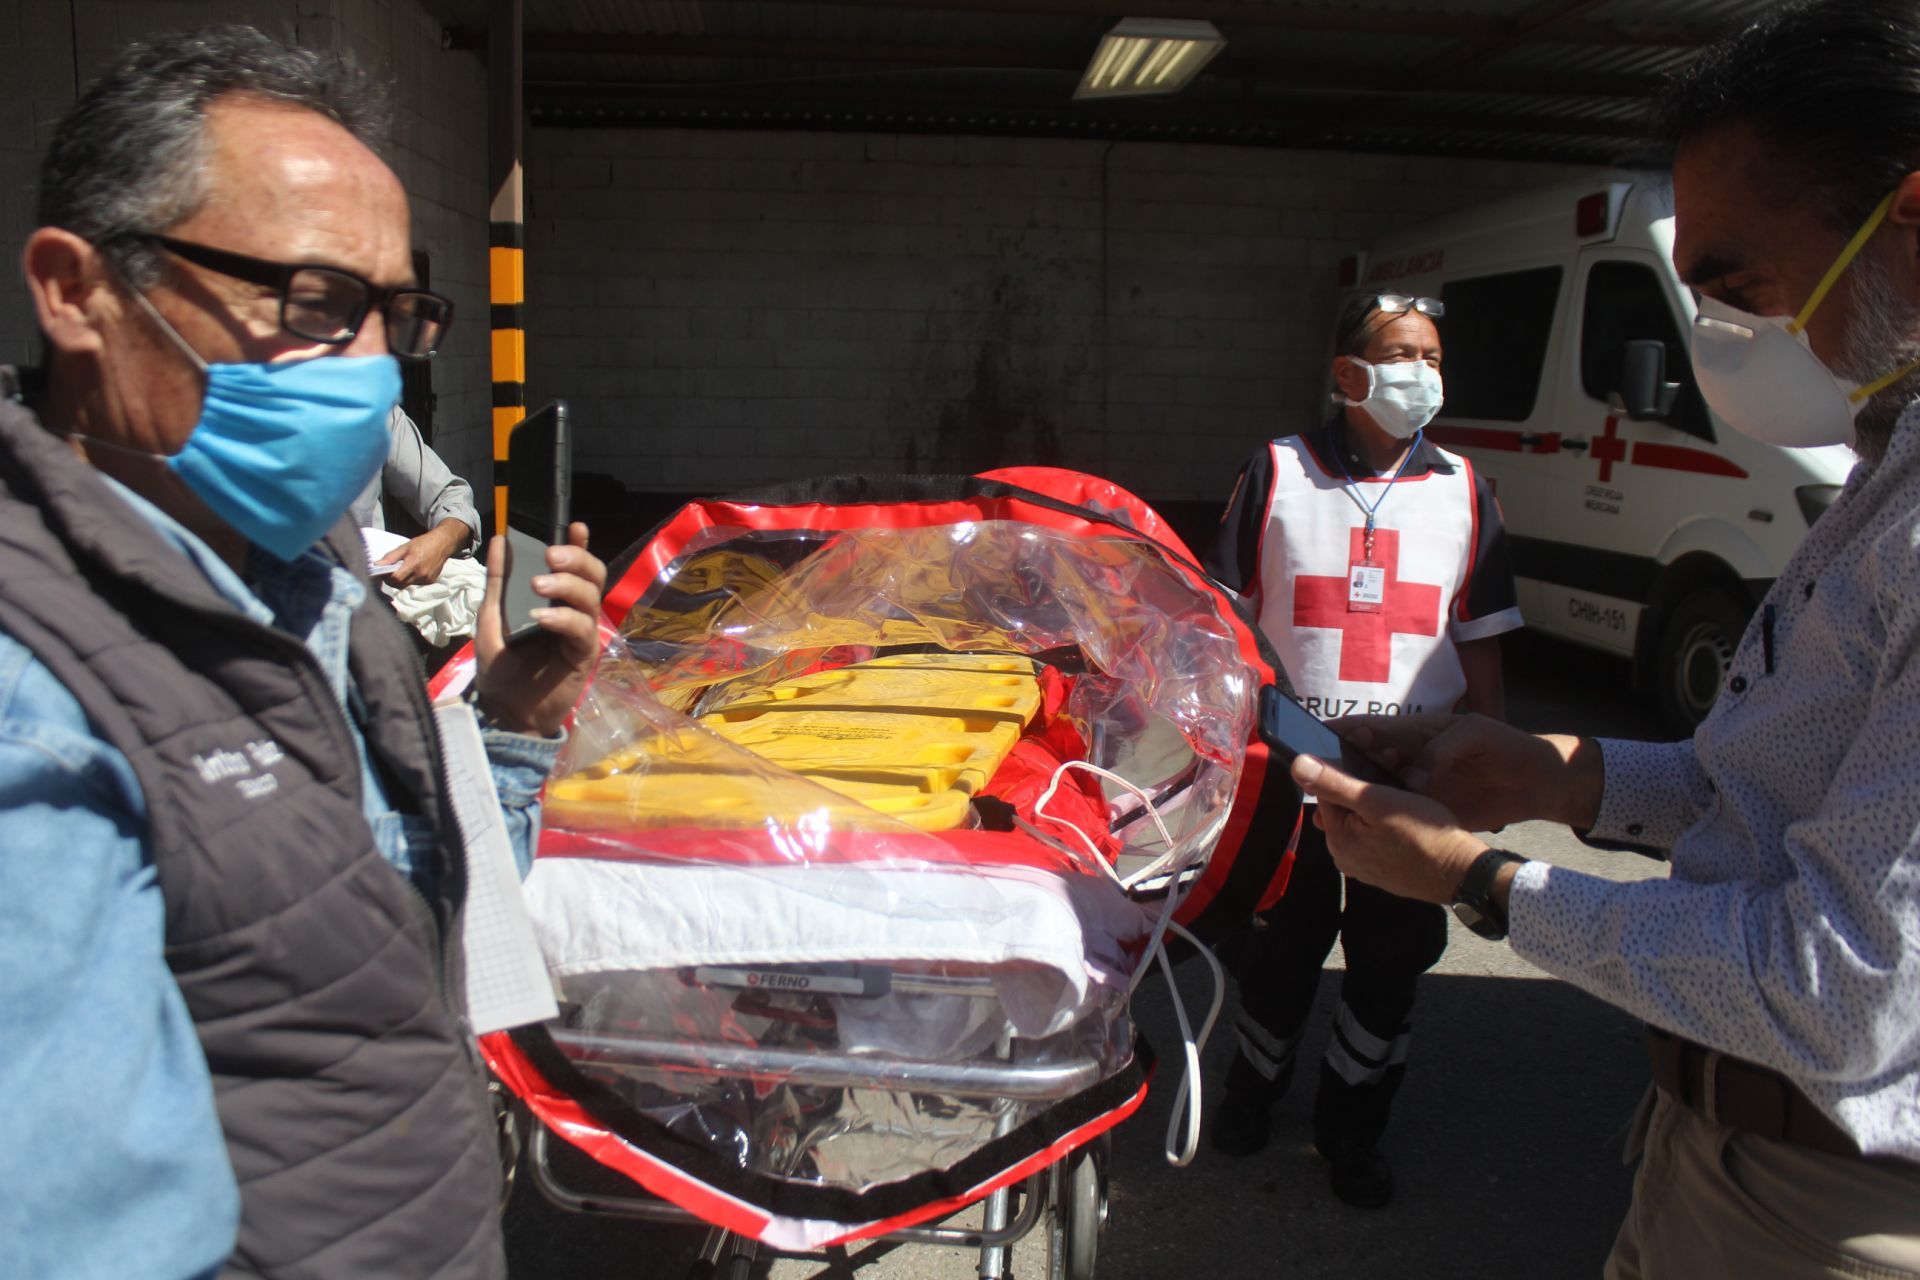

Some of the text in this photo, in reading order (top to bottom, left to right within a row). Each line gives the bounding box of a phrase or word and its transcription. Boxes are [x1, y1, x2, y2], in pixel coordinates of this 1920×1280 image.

[1569, 598, 1626, 632] CHIH-151
[1295, 696, 1358, 718] RUZ
[760, 973, 810, 988] FERNO
